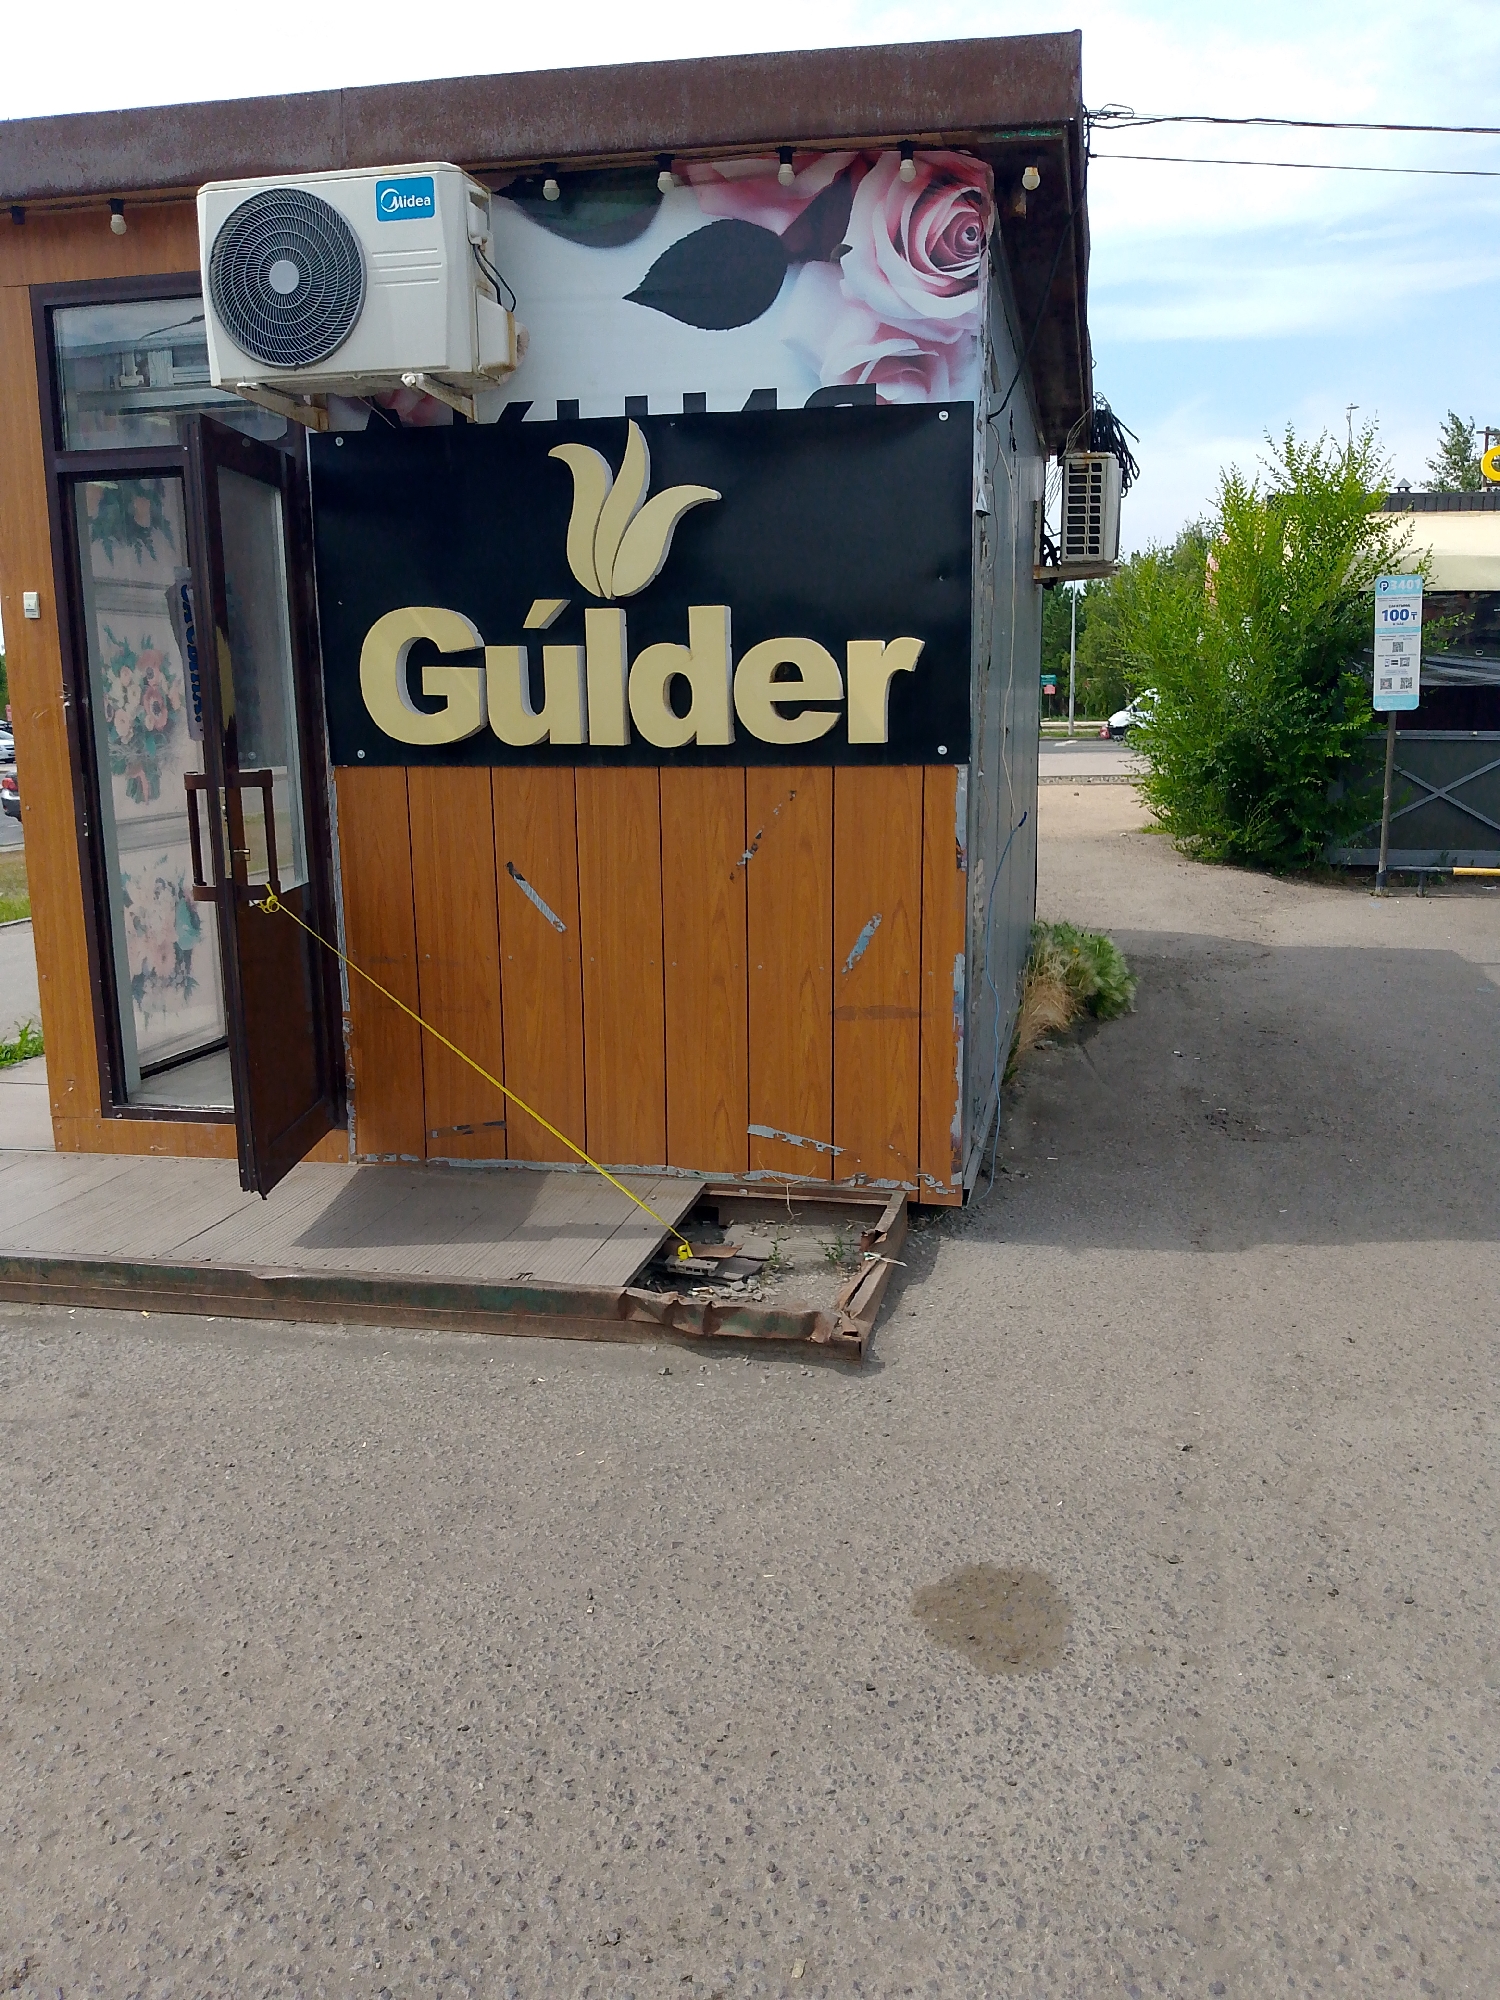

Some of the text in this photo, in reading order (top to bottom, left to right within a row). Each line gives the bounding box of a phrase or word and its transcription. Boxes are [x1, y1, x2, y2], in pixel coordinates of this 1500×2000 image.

[383, 190, 432, 211] Midea
[1391, 579, 1421, 591] 3401
[358, 598, 926, 748] Gúlder
